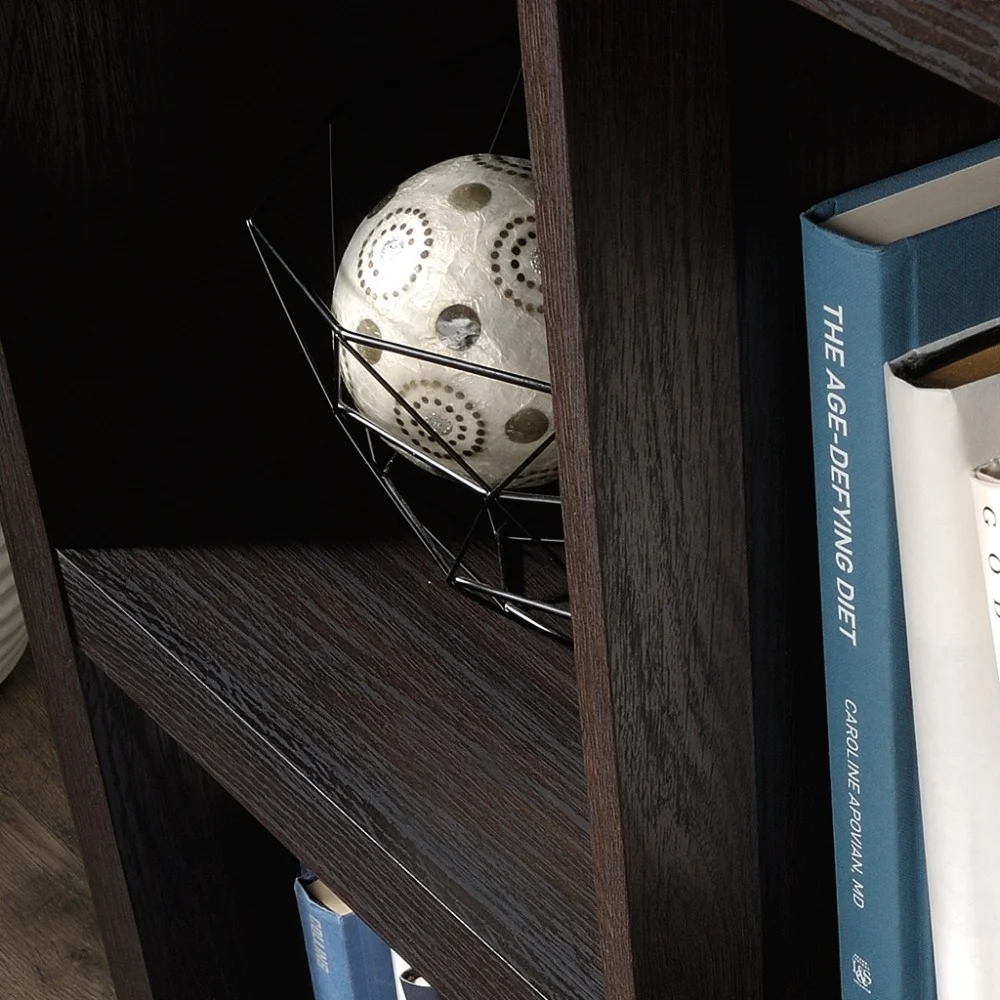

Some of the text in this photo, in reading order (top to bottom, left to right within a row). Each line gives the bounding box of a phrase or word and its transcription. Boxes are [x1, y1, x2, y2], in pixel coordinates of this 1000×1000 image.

[823, 304, 858, 648] THE AGE-DEFYING DIET
[844, 698, 862, 795] CAROLINE
[852, 882, 865, 909] MD
[309, 914, 330, 975] COLLINS
